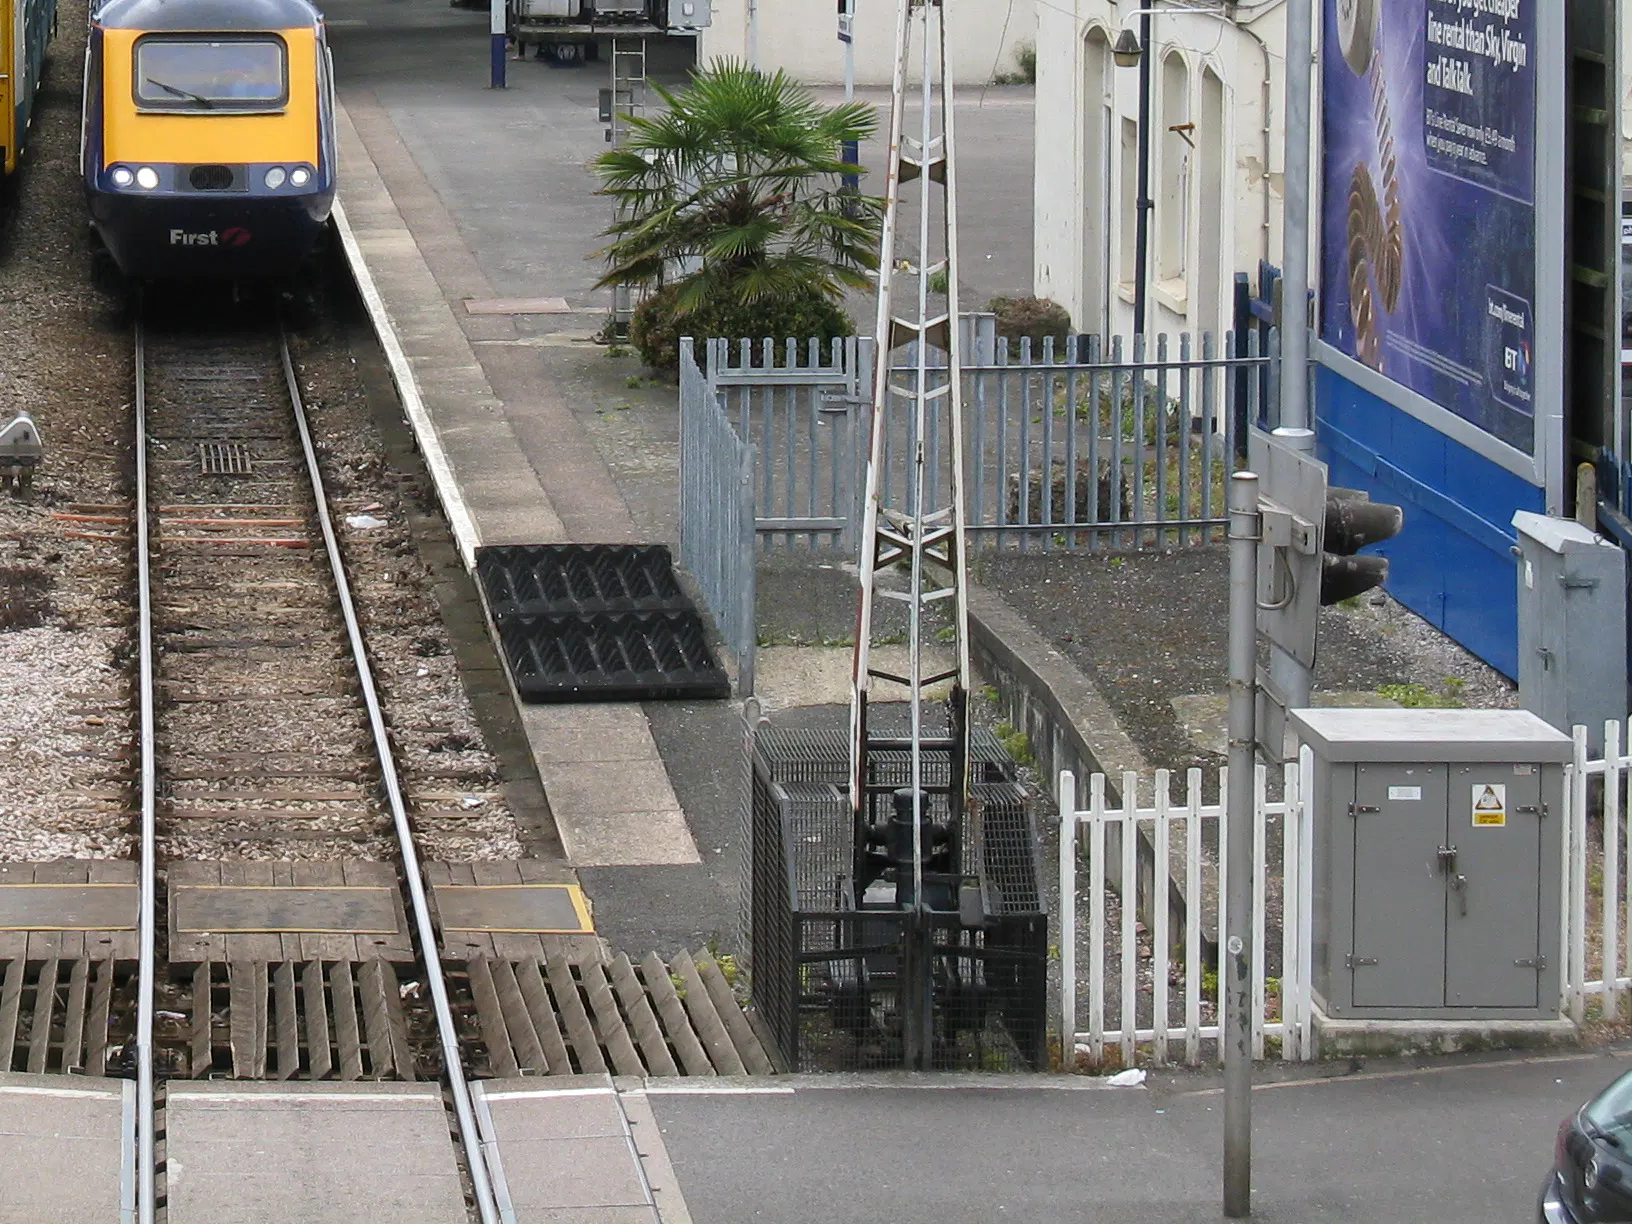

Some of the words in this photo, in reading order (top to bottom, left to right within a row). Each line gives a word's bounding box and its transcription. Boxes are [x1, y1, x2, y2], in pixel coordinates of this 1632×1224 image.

[1428, 10, 1442, 44] line
[1442, 18, 1465, 50] rental
[1465, 19, 1485, 55] than
[1485, 24, 1501, 67] Sky,
[1501, 28, 1527, 72] Virgin
[1427, 55, 1442, 87] and
[170, 229, 218, 245] First
[1505, 346, 1517, 371] BT
